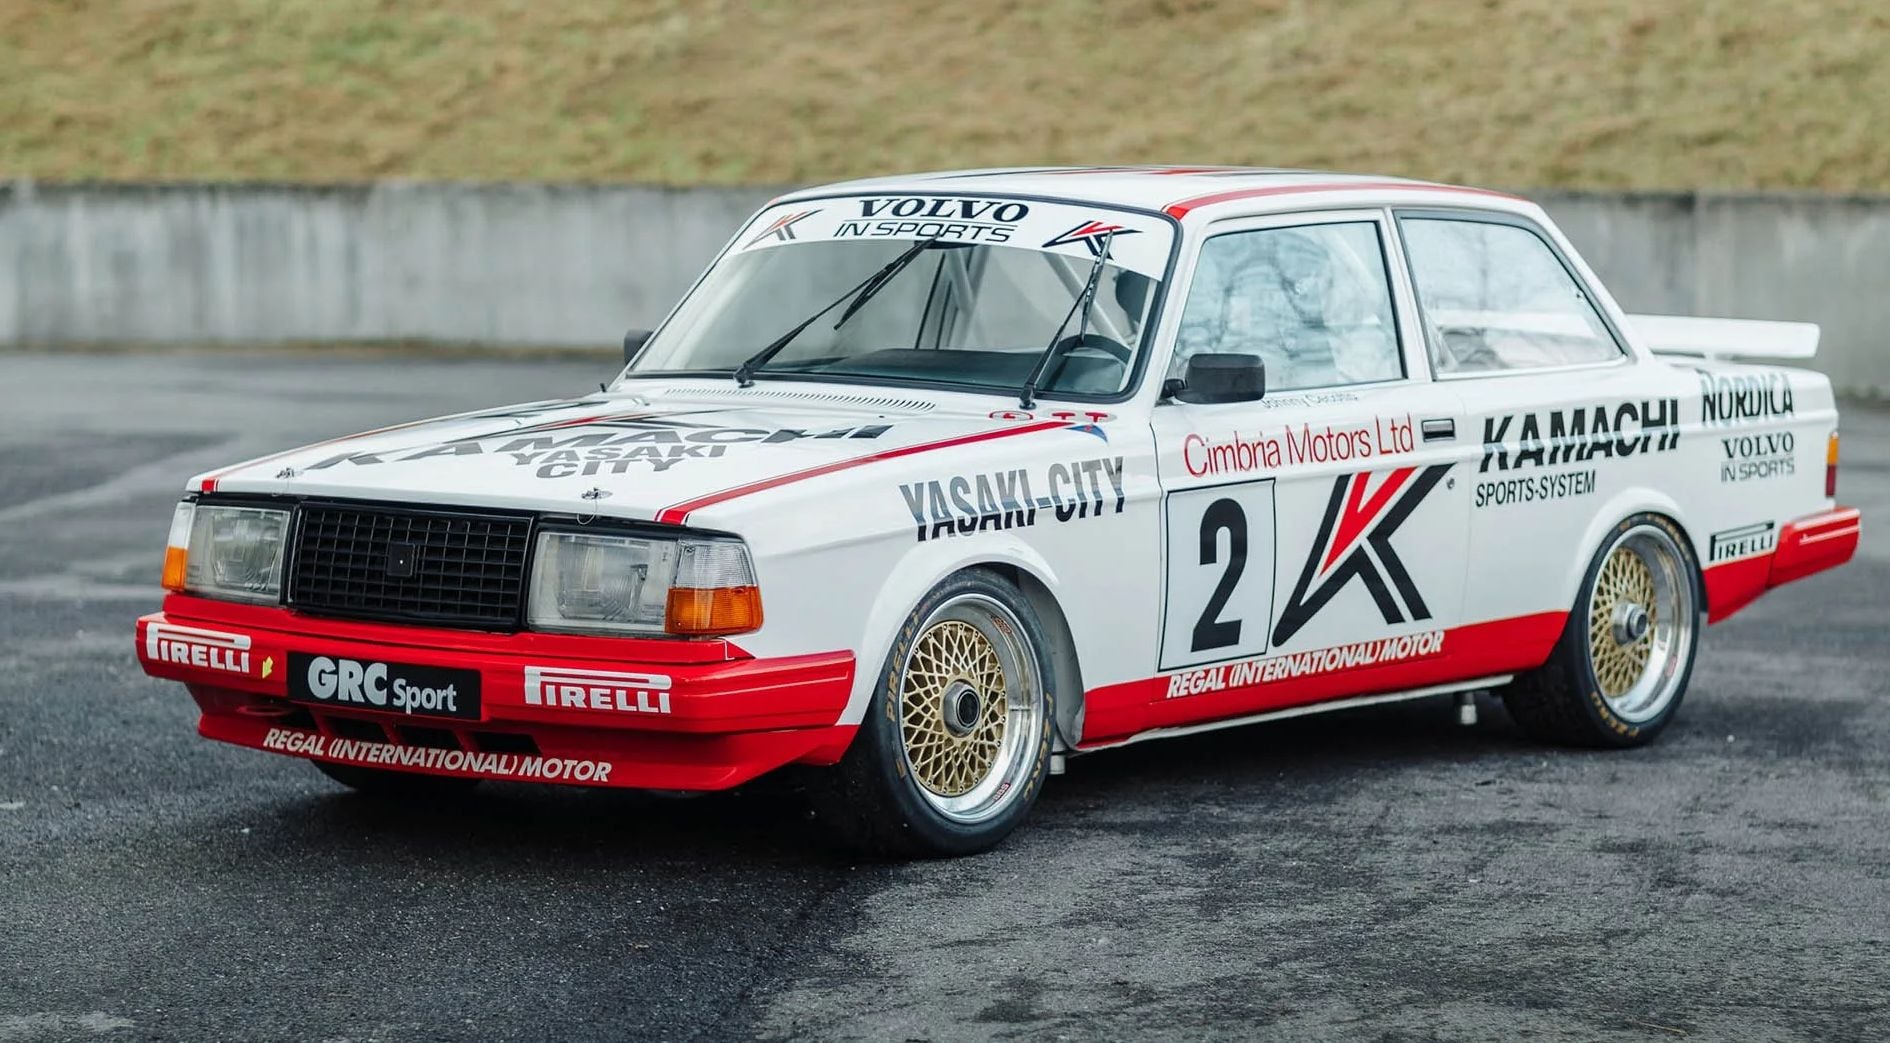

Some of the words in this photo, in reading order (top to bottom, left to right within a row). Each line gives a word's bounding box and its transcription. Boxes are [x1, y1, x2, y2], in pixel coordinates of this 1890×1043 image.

[833, 222, 871, 238] IN
[871, 222, 1016, 243] SPORTS
[859, 198, 1030, 223] VOLVO
[1701, 370, 1794, 428] NORDICA
[312, 424, 895, 470] KAMACHI
[513, 445, 728, 466] YASAKI
[1183, 430, 1282, 478] Cimbria
[1285, 424, 1372, 464] Motors
[1376, 412, 1415, 455] Ltd
[1478, 398, 1681, 474] KAMACHI
[1721, 432, 1795, 460] VOLVO
[536, 457, 684, 479] CITY
[1476, 470, 1597, 508] SPORTS-SYSTEM
[1721, 462, 1736, 482] IN
[1738, 457, 1795, 481] SPORTS
[900, 456, 1126, 543] YASAKI-CITY
[1710, 521, 1775, 561] PIRELLI
[1191, 497, 1248, 653] 2
[146, 622, 252, 673] PIRELLI
[1166, 663, 1227, 699] REGAL
[1228, 639, 1381, 687] (INTERNATIONAL)
[1379, 629, 1445, 660] MOTOR
[307, 656, 388, 706] GRC
[393, 677, 457, 714] Sport
[524, 665, 672, 714] PIRELLI
[263, 727, 325, 756] REGAL
[328, 737, 519, 777] (INTERNATIONAL)
[519, 756, 613, 783] MOTOR
